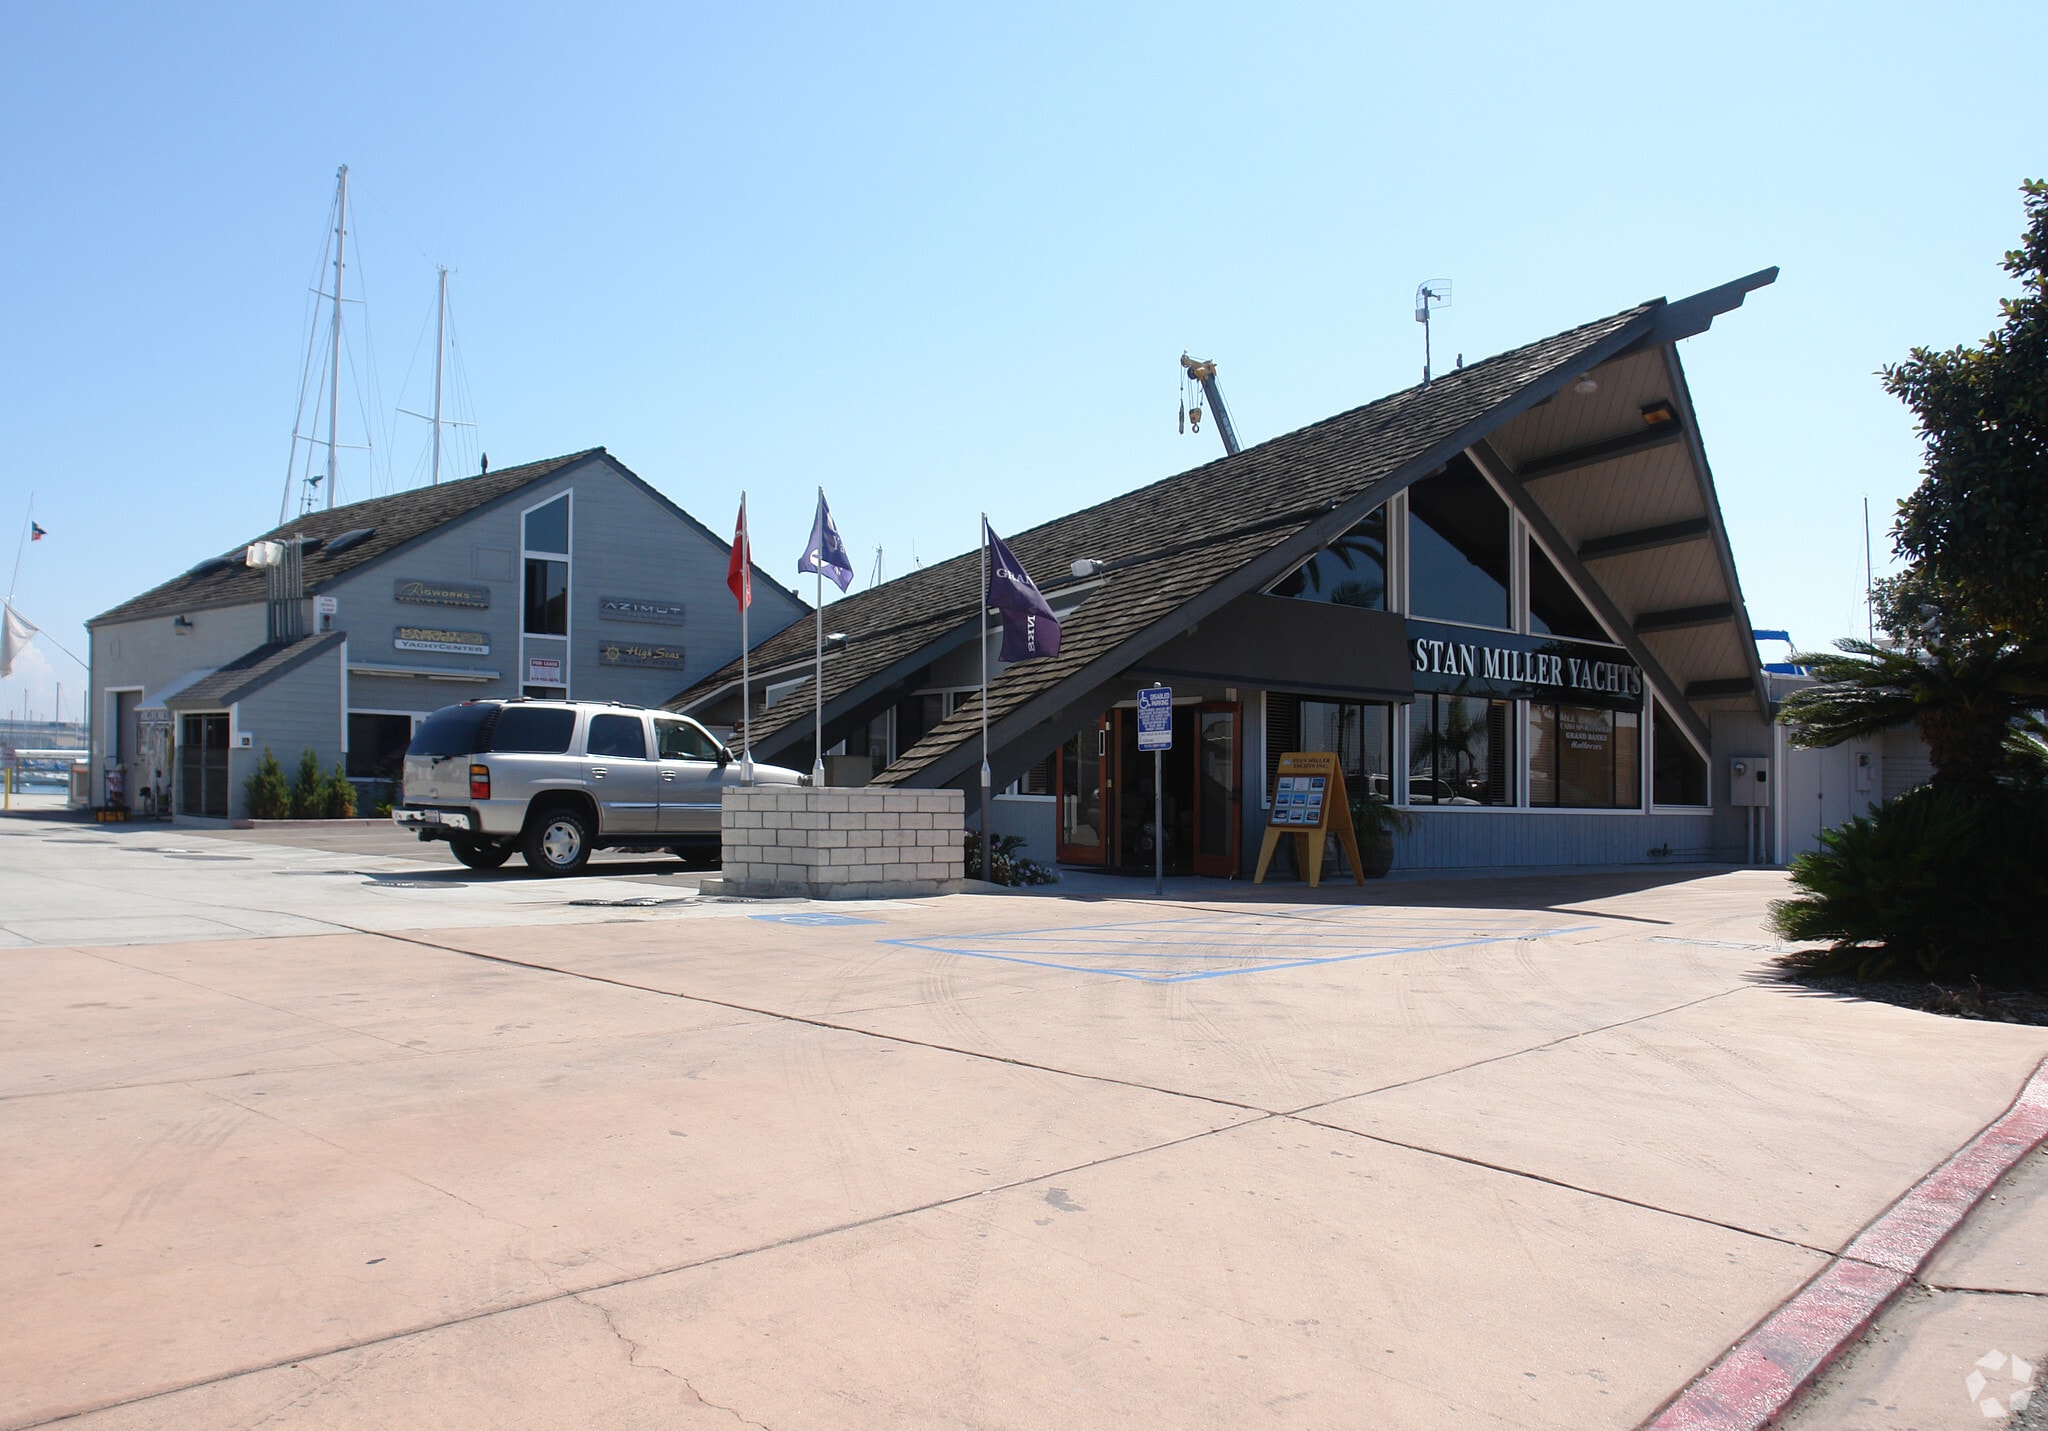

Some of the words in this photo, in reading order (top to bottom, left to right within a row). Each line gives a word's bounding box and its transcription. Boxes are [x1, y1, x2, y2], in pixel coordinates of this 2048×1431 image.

[996, 567, 1035, 586] GRAN
[400, 582, 470, 599] RIGWORKS
[605, 601, 681, 615] AZIMUT
[625, 645, 652, 660] High
[653, 647, 680, 659] Seas
[1416, 638, 1475, 677] STAN
[1483, 646, 1563, 686] MILLER
[1568, 657, 1641, 695] YACHTS
[1150, 692, 1170, 700] DISABLED
[1151, 699, 1169, 707] PARKING
[1565, 731, 1587, 739] GRAND
[1587, 733, 1608, 742] BANKS
